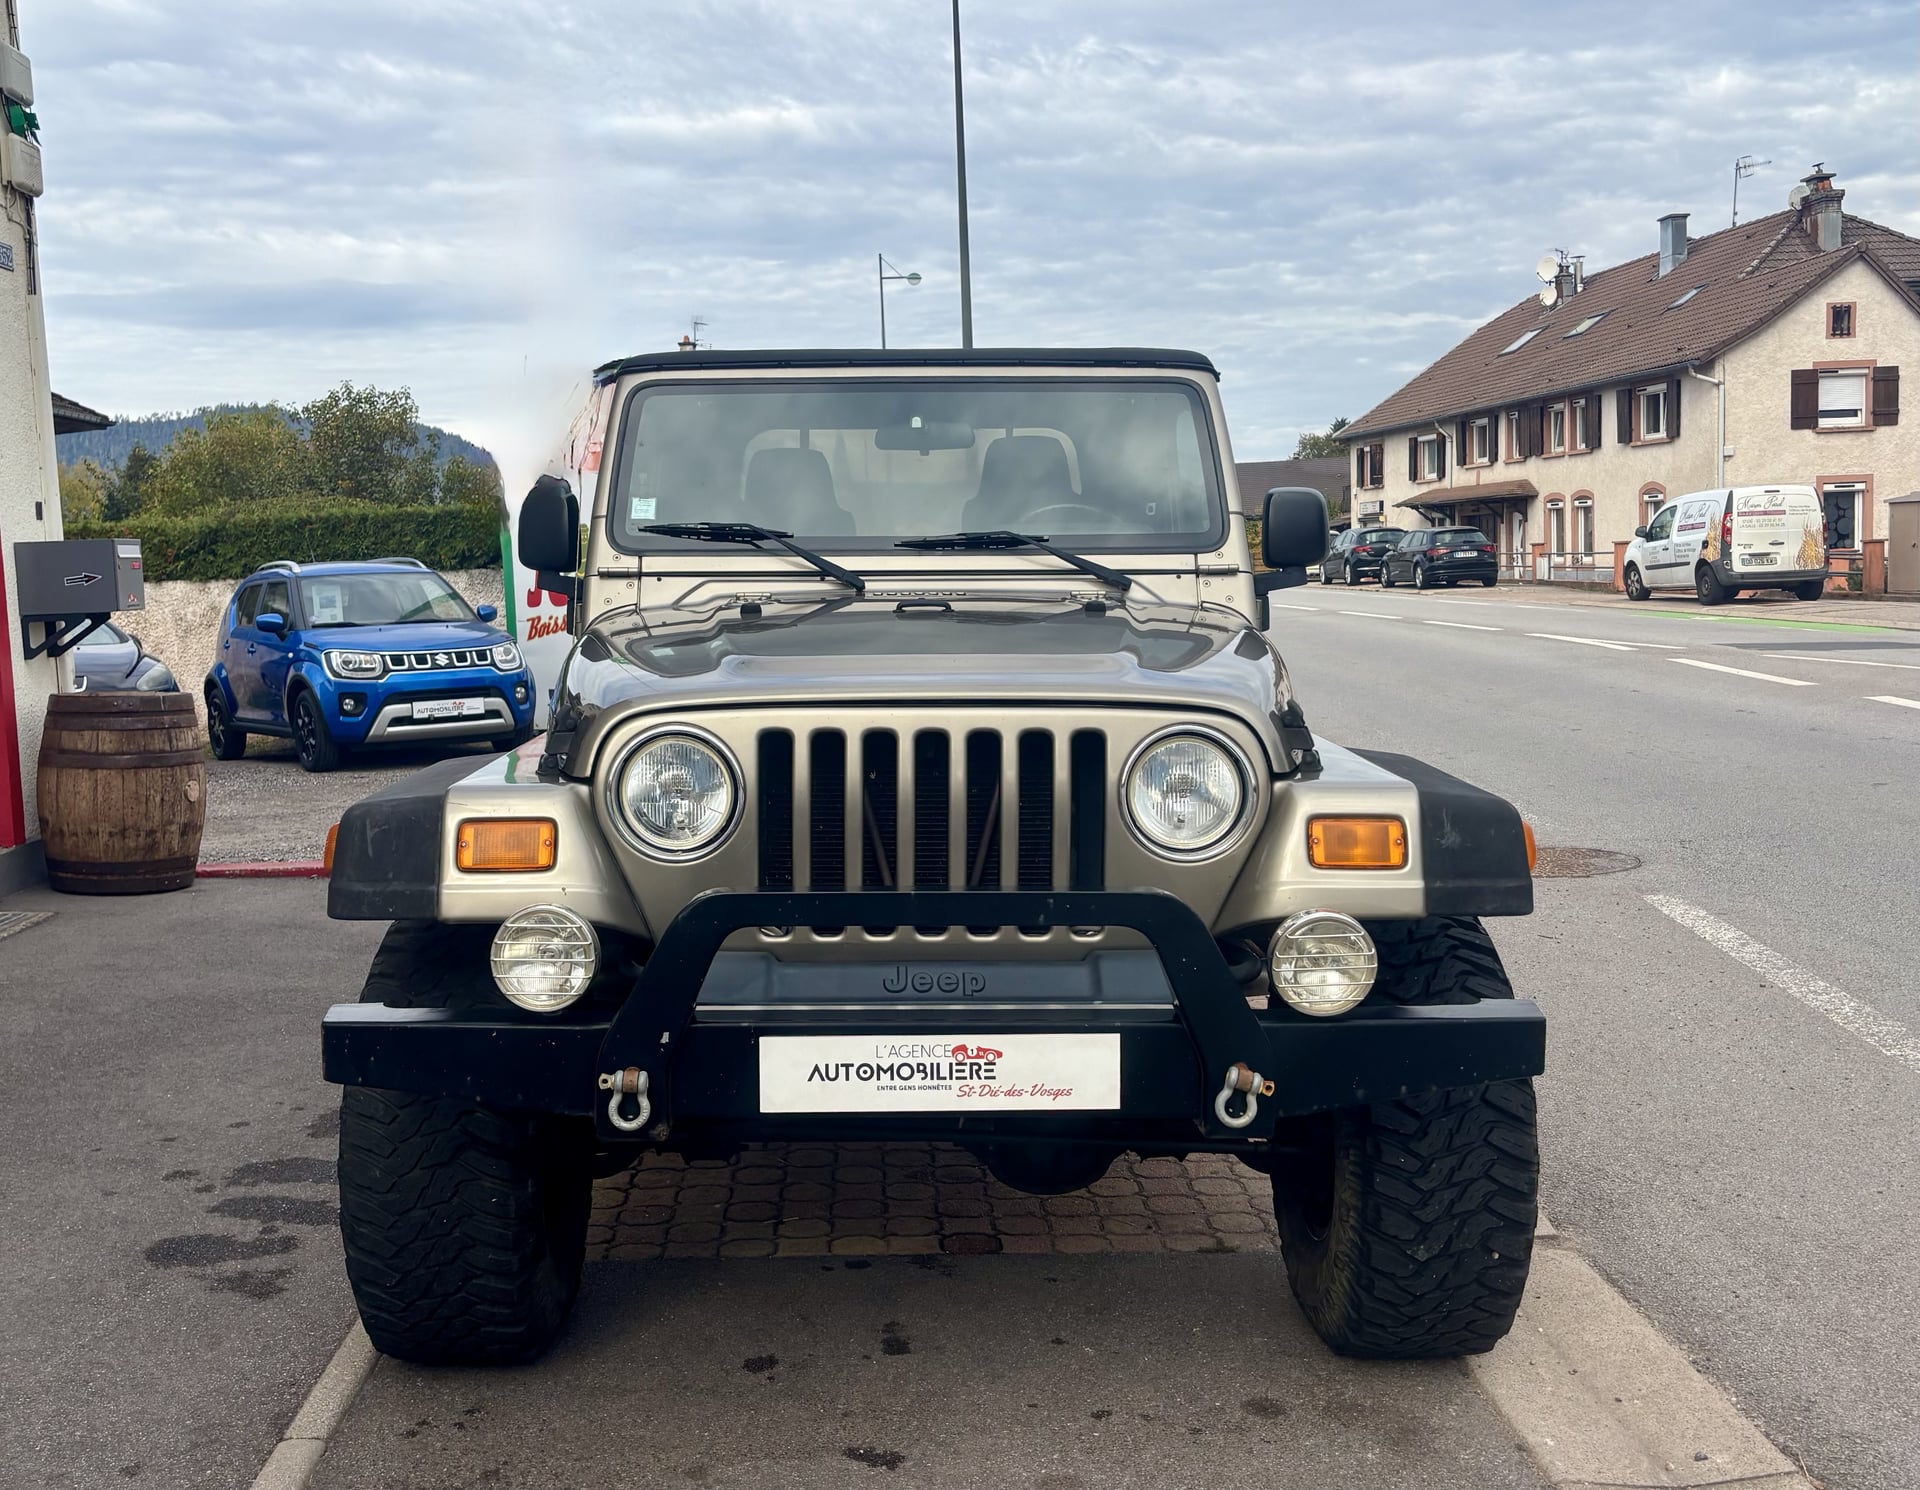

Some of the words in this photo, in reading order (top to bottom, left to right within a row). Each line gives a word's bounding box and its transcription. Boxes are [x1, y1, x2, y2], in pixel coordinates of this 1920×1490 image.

[526, 614, 567, 642] Boiss
[883, 965, 986, 997] Jeep
[875, 1044, 952, 1059] L'AGENCE
[918, 1083, 953, 1091] HONNÊTES
[956, 1083, 1073, 1101] St-Dié-des-Vosges
